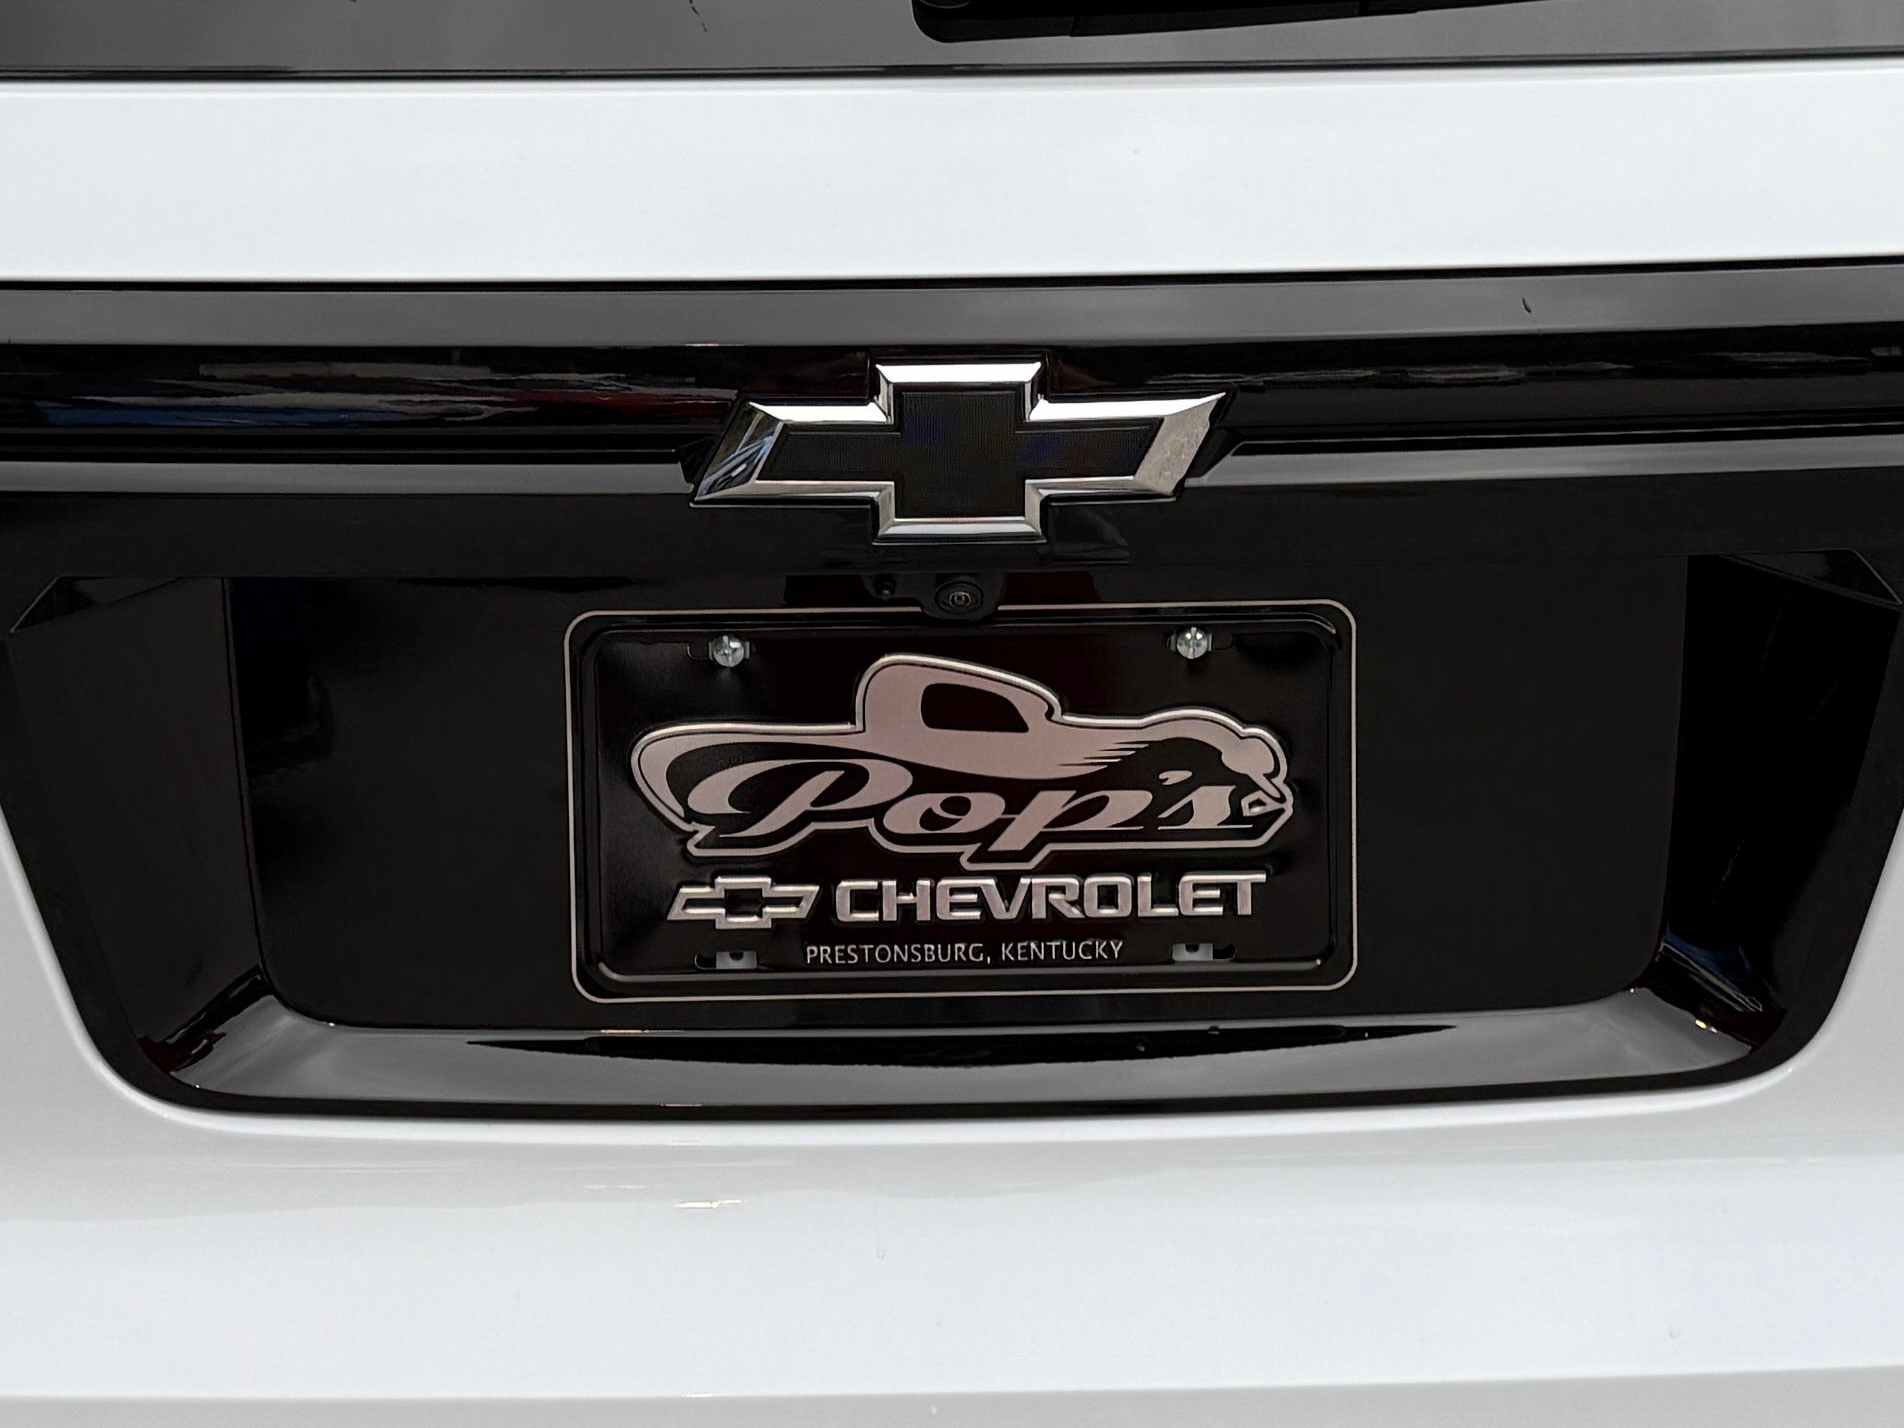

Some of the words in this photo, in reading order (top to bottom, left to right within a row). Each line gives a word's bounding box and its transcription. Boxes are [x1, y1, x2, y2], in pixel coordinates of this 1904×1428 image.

[686, 758, 1253, 851] Pop's
[834, 870, 1268, 924] CHEVROLET
[806, 942, 994, 966] PRESTONSBURG,
[1001, 940, 1124, 963] KENTUCKY
